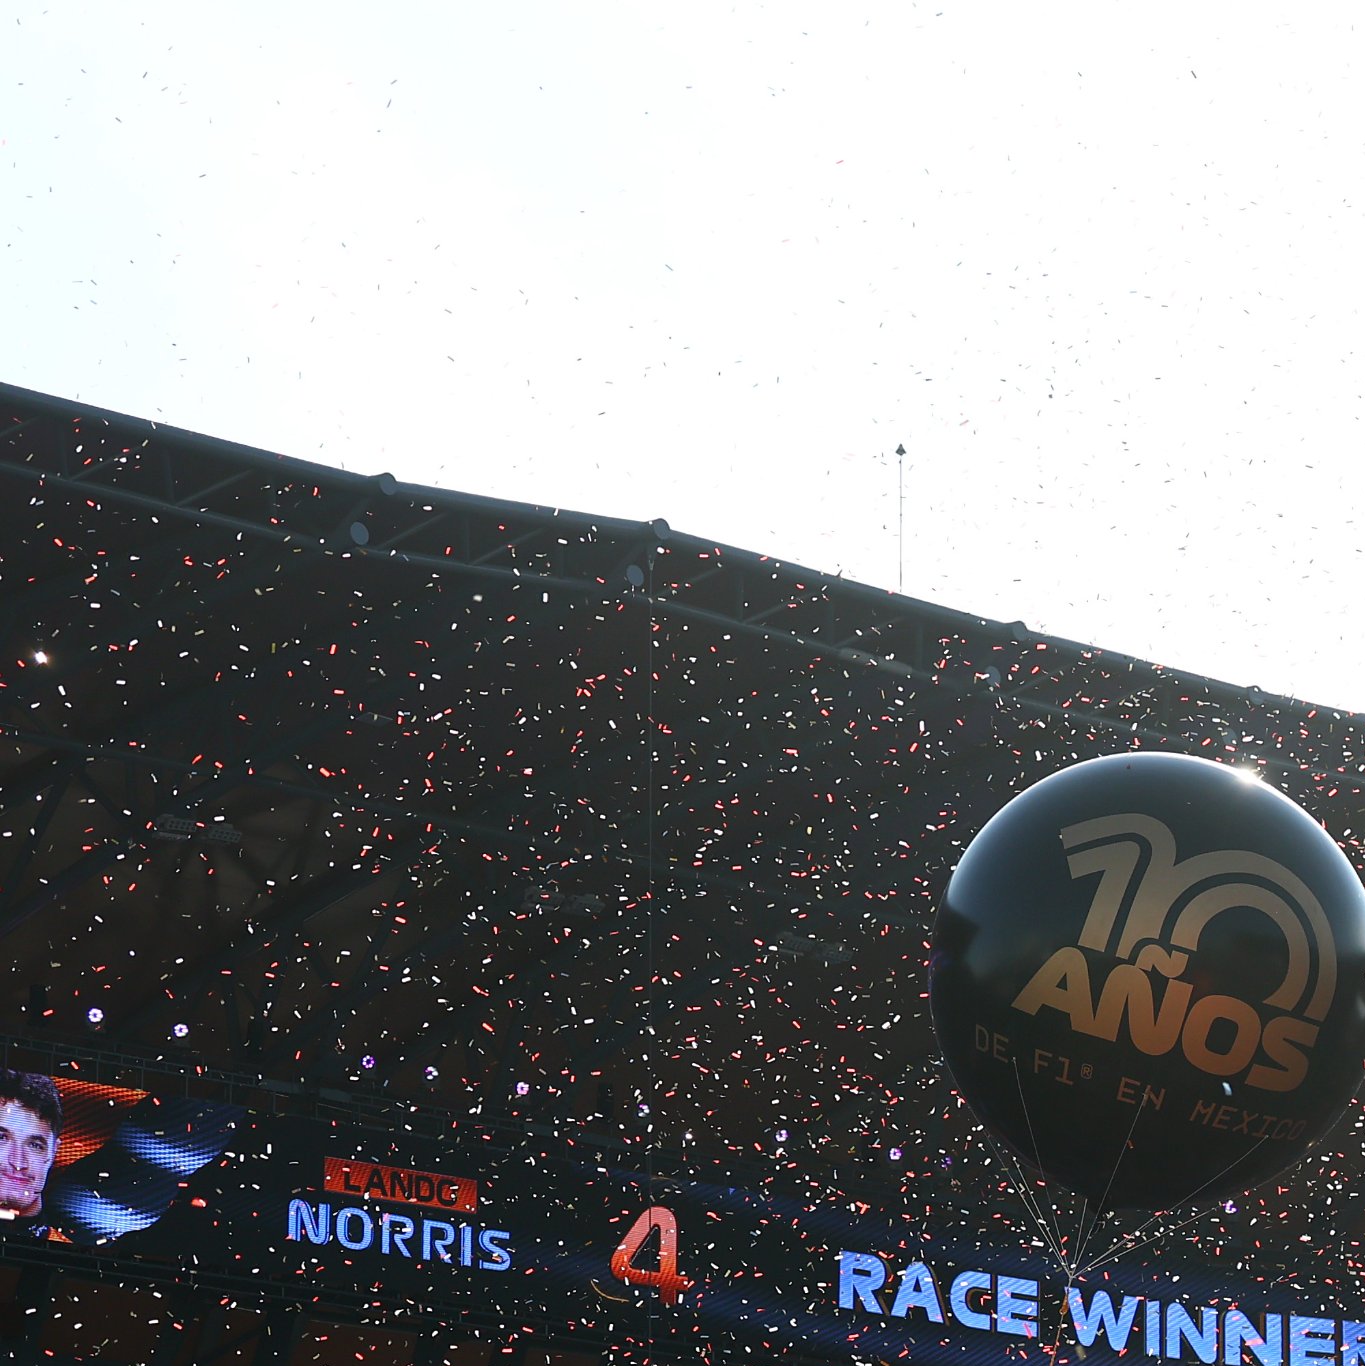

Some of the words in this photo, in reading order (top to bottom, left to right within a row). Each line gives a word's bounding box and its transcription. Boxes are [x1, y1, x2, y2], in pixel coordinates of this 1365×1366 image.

[1061, 813, 1336, 1021] 10
[1011, 944, 1320, 1093] AÑOS
[975, 1023, 1009, 1064] DE
[1116, 1076, 1166, 1111] EN
[342, 1170, 460, 1209] LANDO
[286, 1198, 513, 1272] NORRIS
[609, 1205, 689, 1304] 4
[837, 1250, 1041, 1339] RACE
